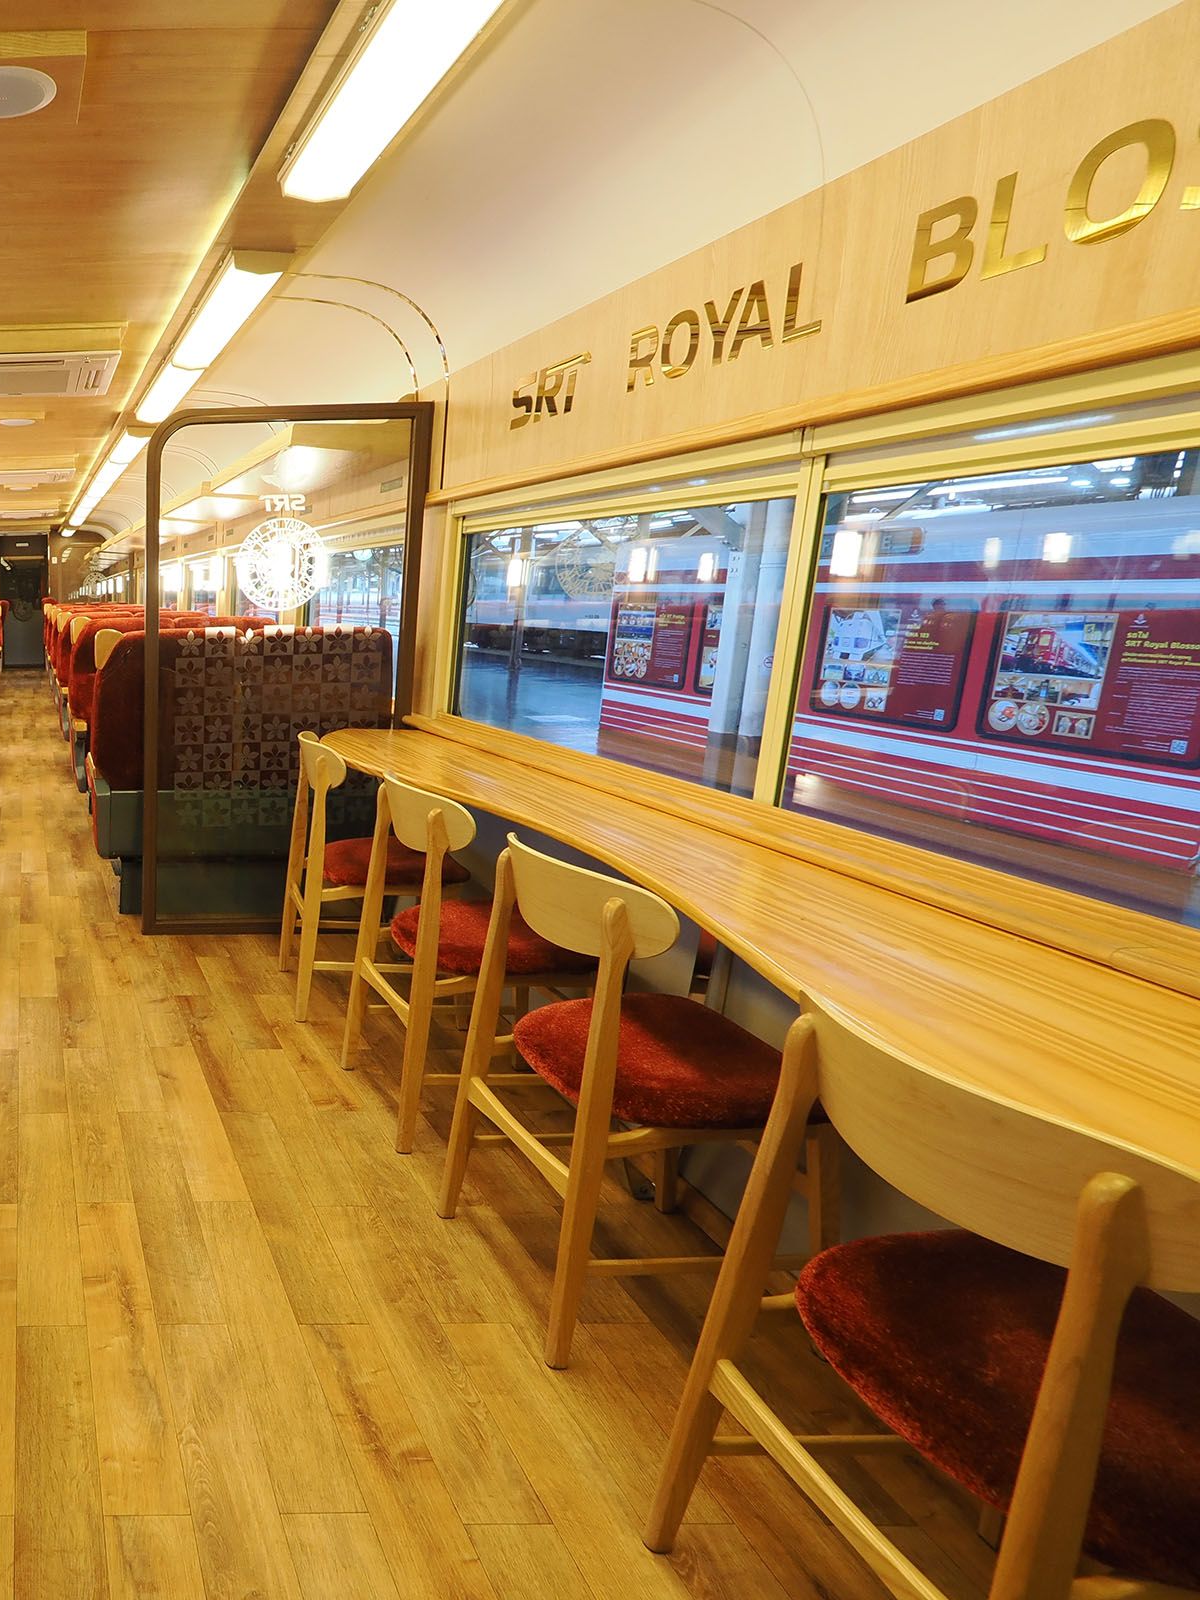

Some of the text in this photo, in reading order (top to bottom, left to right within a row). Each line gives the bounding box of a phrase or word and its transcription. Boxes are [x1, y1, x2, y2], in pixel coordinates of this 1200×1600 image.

[510, 118, 1200, 430] SRT ROYAL BLO
[1143, 641, 1169, 649] Royal
